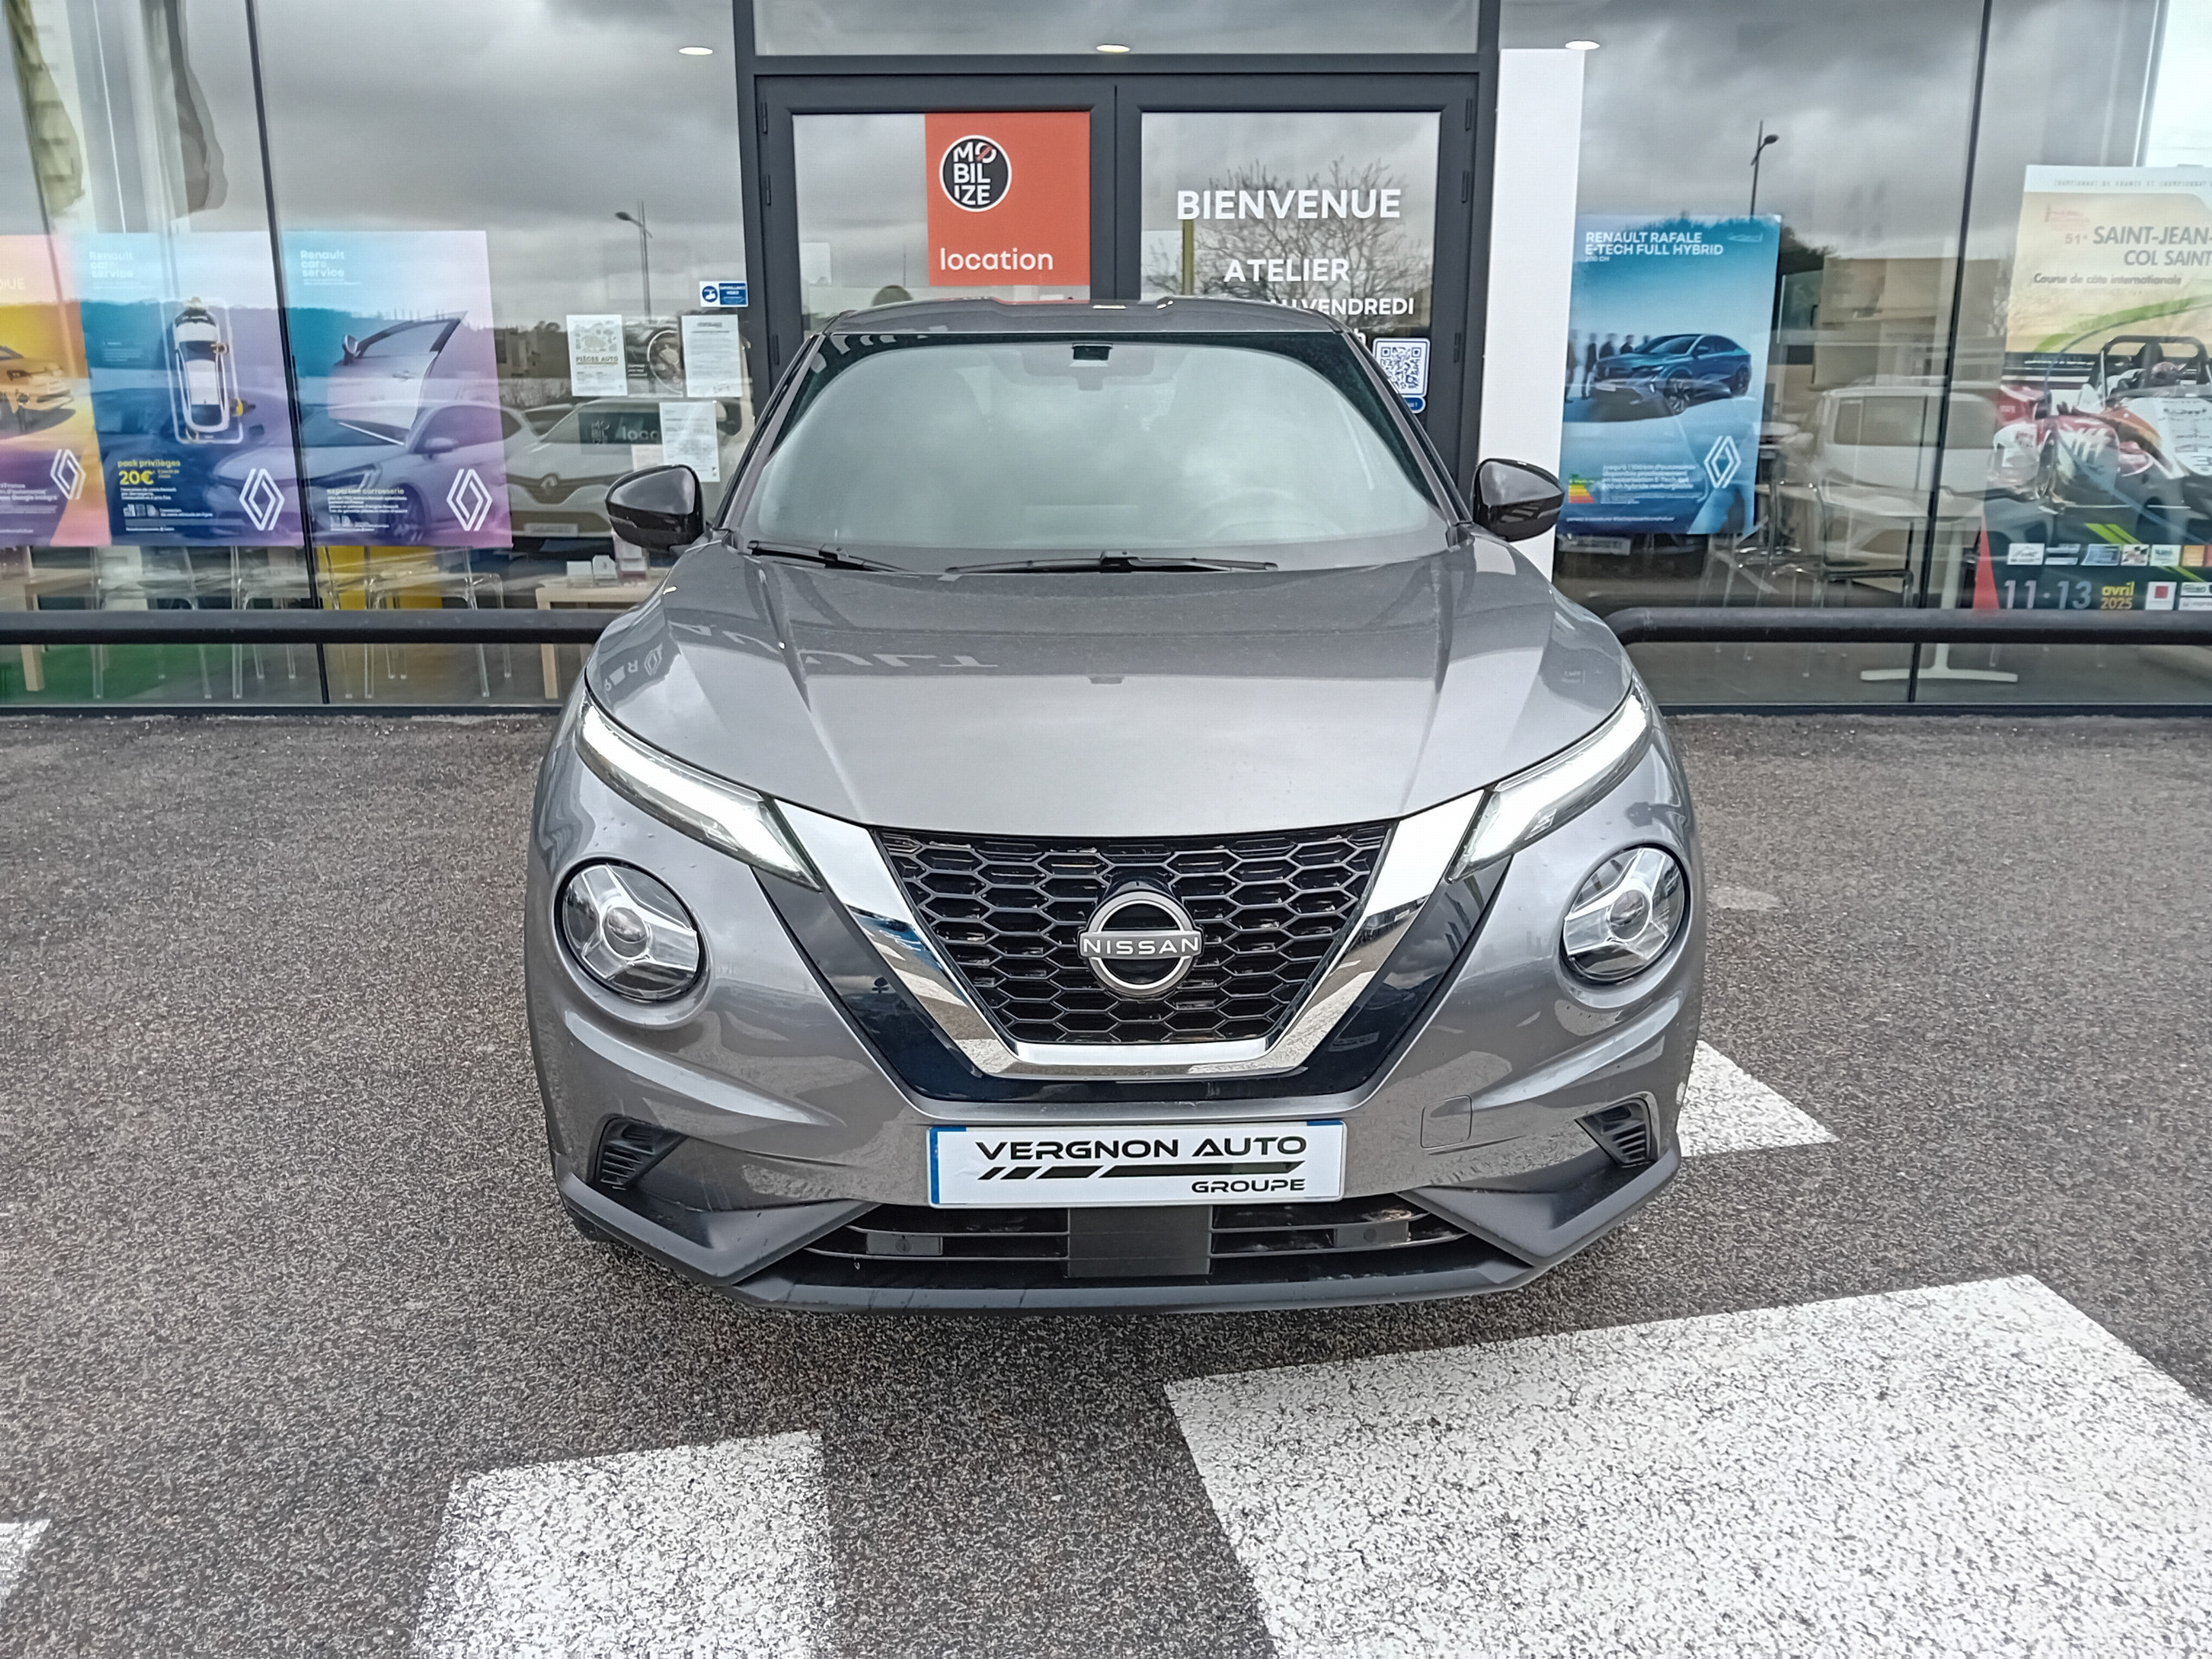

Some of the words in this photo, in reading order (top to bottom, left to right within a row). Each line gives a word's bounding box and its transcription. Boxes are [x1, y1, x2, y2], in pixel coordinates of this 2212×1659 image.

[1176, 188, 1402, 219] BIENVENUE
[1585, 232, 1648, 244] RENAULT
[1649, 232, 1703, 244] RAFALE
[300, 250, 346, 260] Renault
[1585, 243, 1634, 256] E-TECH
[1636, 244, 1671, 256] FULL
[1672, 244, 1725, 256] HYBRID
[2123, 249, 2159, 266] COL
[939, 247, 1054, 270] location
[302, 267, 346, 277] service
[1224, 258, 1351, 283] ATELIER
[1301, 297, 1415, 315] VENDREDI
[2101, 580, 2136, 597] avril
[2100, 597, 2133, 610] 2025
[1083, 937, 1199, 956] NISSAN
[975, 1139, 1179, 1160] VERGNON
[1191, 1135, 1307, 1158] AUTO
[1191, 1178, 1306, 1194] GROUPE
